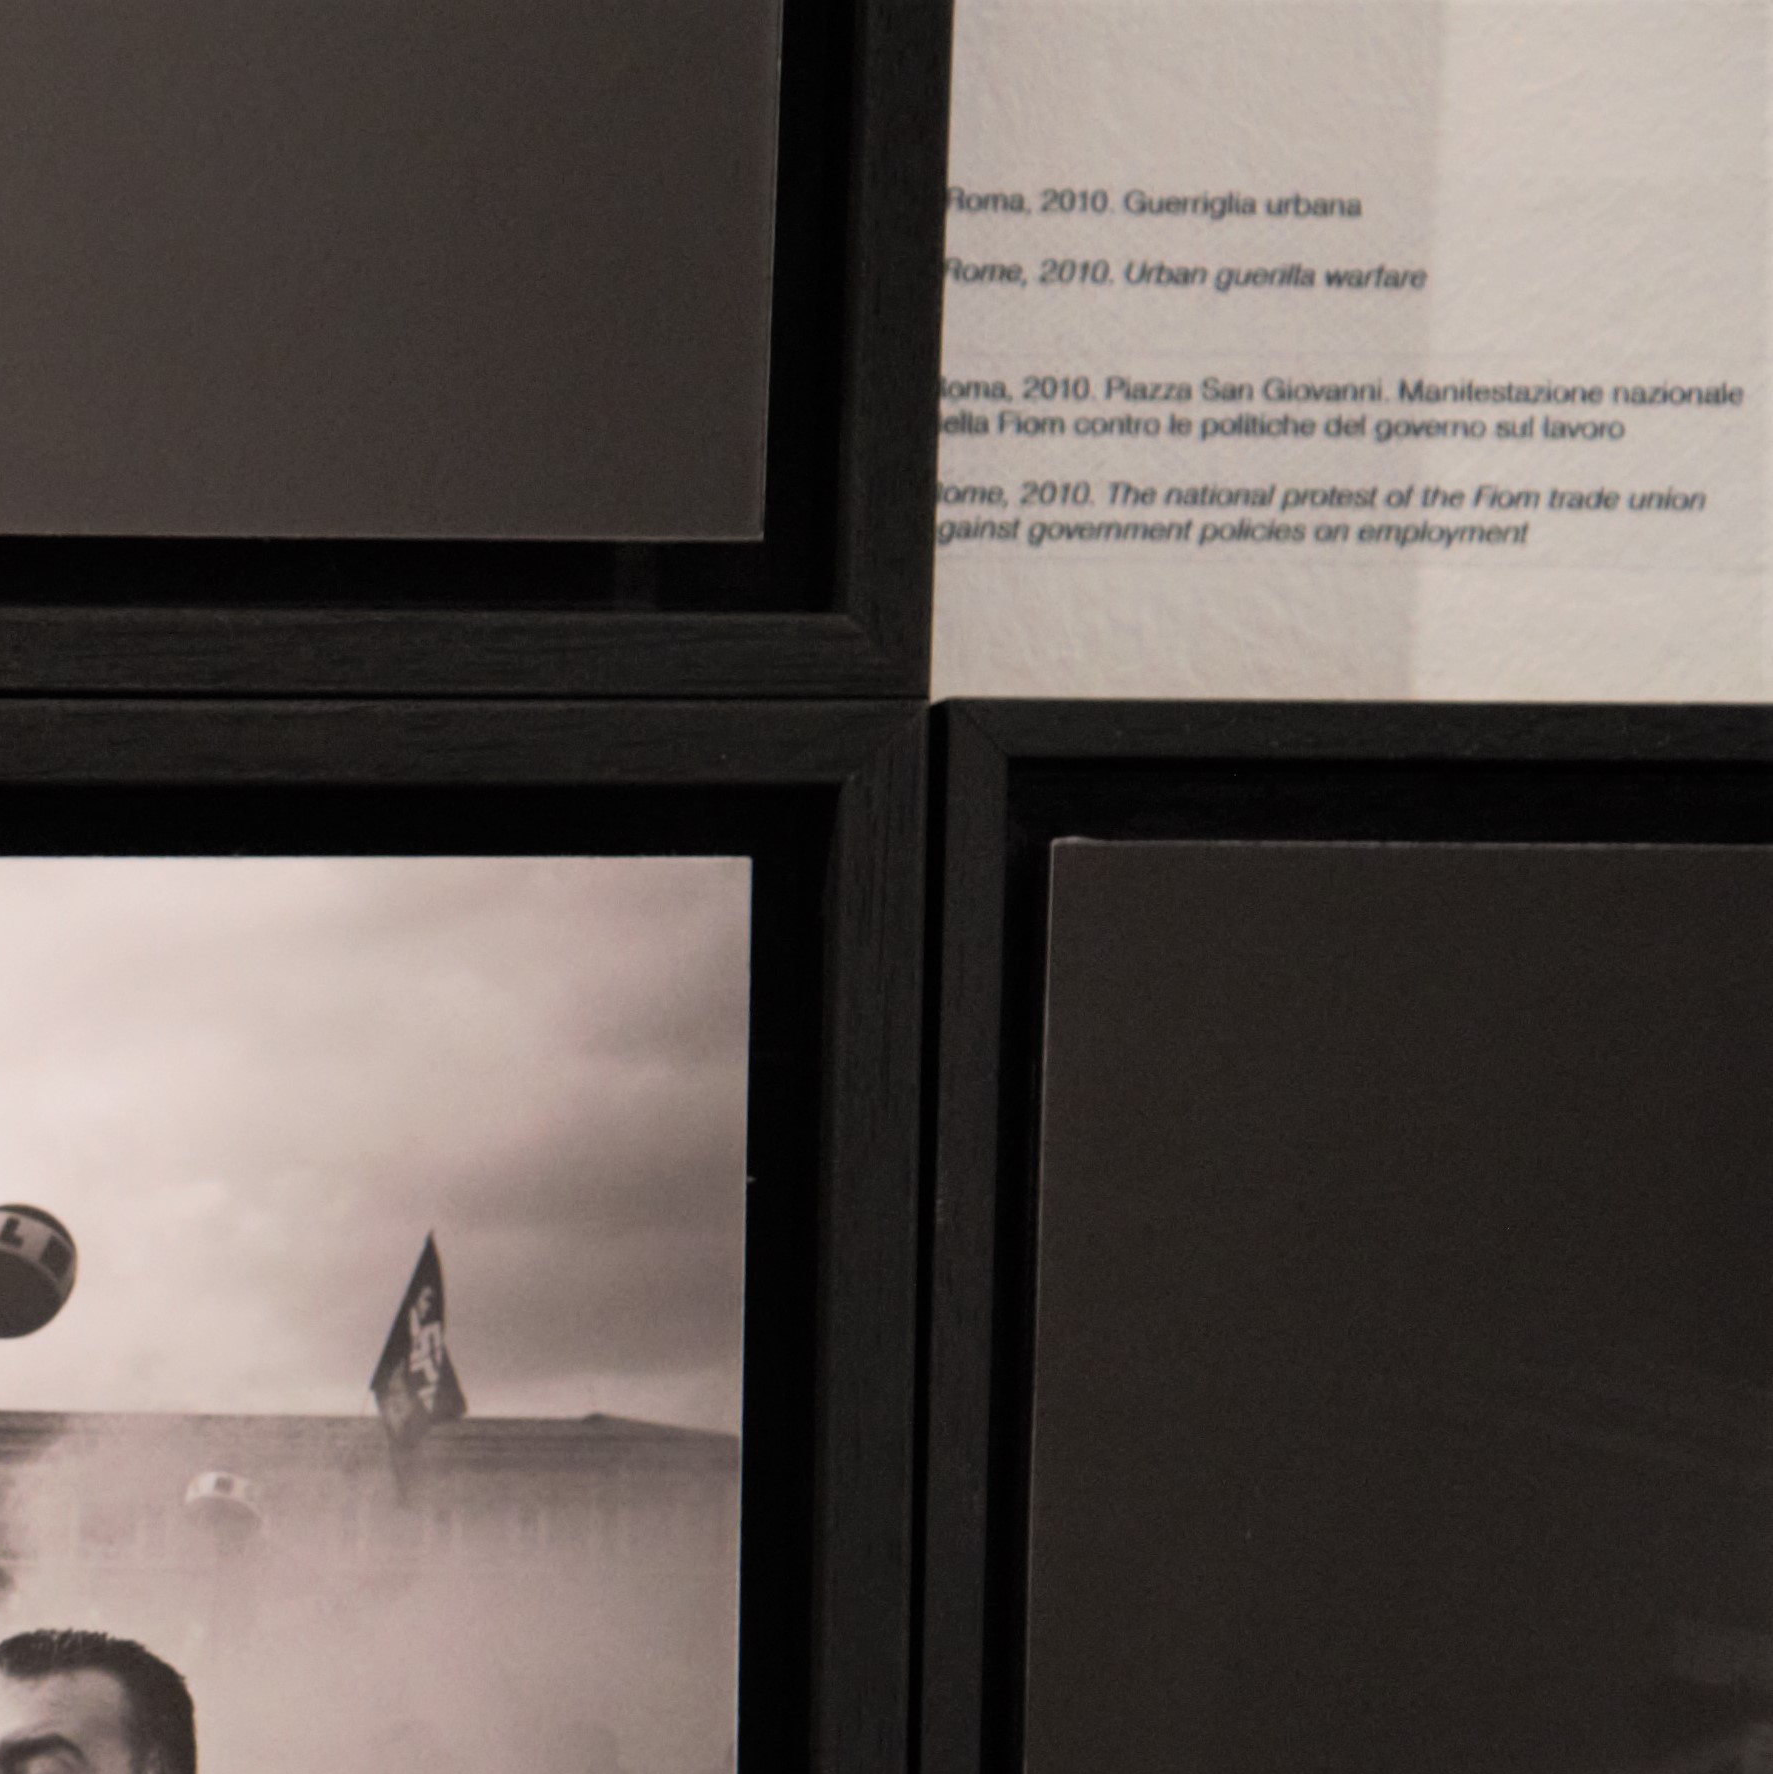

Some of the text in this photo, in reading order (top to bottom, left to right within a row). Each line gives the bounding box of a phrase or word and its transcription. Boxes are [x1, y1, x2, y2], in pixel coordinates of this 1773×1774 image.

[947, 186, 1363, 220] Roma, 2010. Guerriglia urbana
[944, 257, 1028, 288] Rome,
[1038, 258, 1114, 285] 2010.
[1123, 260, 1209, 288] Urban
[1324, 264, 1428, 290] warfare
[940, 376, 1745, 406] oma, 2010. Piazza San Giovanni. Manifestazione nazionale
[997, 411, 1067, 436] Fiom
[1073, 413, 1161, 437] contro
[1167, 413, 1193, 437] le
[1199, 413, 1317, 442] politiche
[1323, 414, 1368, 438] del
[1374, 417, 1488, 444] governo
[1495, 415, 1536, 439] sul
[1542, 415, 1626, 441] lavoro
[1019, 482, 1095, 506] 2010.
[1108, 482, 1157, 506] The
[1163, 484, 1276, 508] national
[1280, 485, 1379, 513] protest
[1384, 484, 1416, 510] of
[1421, 485, 1466, 510] the
[1472, 486, 1542, 511] Fiom
[1548, 486, 1621, 511] trade
[1627, 487, 1707, 512] union
[937, 517, 1530, 549] gainst government policies on employment
